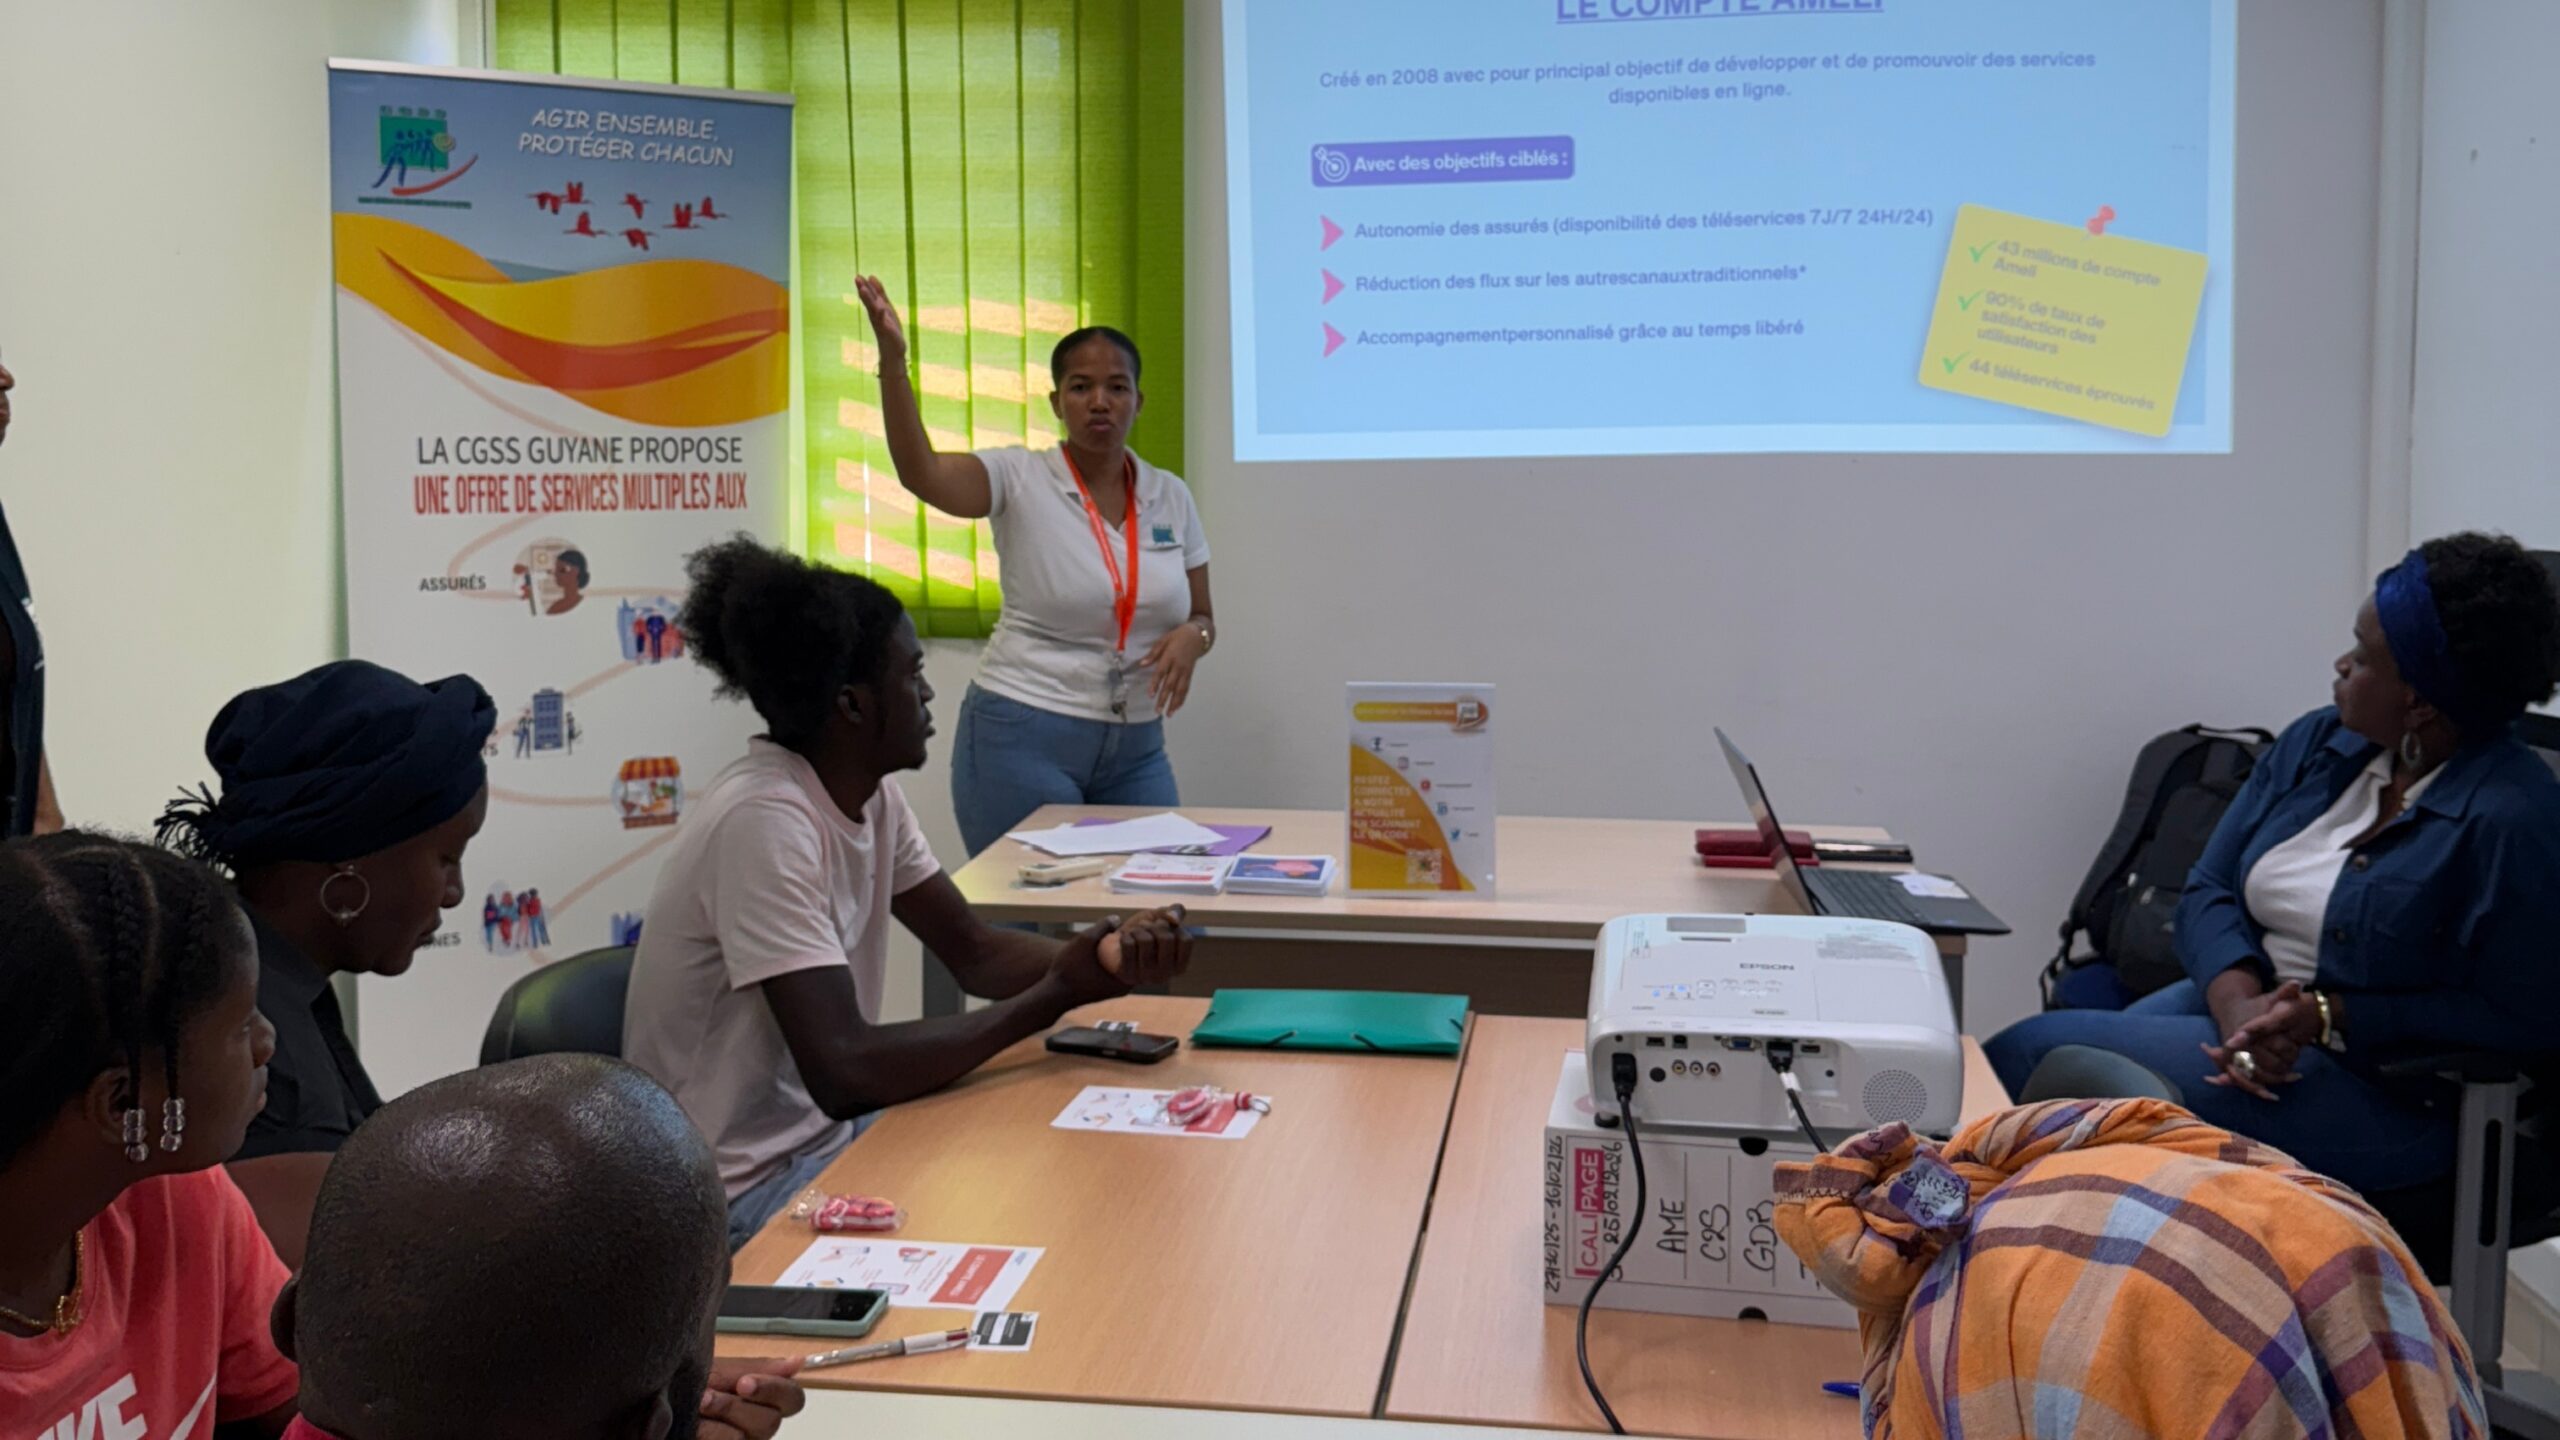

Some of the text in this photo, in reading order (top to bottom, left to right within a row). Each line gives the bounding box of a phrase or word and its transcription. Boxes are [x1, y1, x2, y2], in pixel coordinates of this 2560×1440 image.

[1319, 51, 2096, 88] Créé en 2008 avec pour principal objectif de développer et de promouvoir des services
[1608, 82, 1793, 106] disponibles en ligne.
[532, 108, 719, 142] AGIR ENSEMBLE,
[518, 129, 734, 166] PROTÉGER CHACUN
[1354, 156, 1396, 173] Avec
[1398, 155, 1431, 171] des
[1433, 151, 1506, 174] objectifs
[1508, 150, 1560, 167] ciblés
[1354, 208, 1935, 239] Autonomie des assurés (disponibilité des téléservices 7J/7 24H/24)
[1356, 274, 1441, 292] Réduction
[1445, 273, 1477, 289] des
[1480, 272, 1511, 289] flux
[1514, 274, 1543, 288] sur
[1546, 271, 1571, 287] les
[2022, 246, 2079, 270] millions
[2082, 258, 2101, 275] de
[2103, 265, 2161, 287] compte
[1982, 310, 2097, 344] satisfaction des
[2028, 302, 2048, 317] de
[2050, 305, 2083, 325] taux
[2085, 314, 2106, 330] de
[1356, 318, 1805, 347] Accompagnementpersonnalisé grâce au temps libéré
[1977, 328, 2059, 355] utilisateurs
[1969, 358, 2156, 412] 44 téléservices éprouvés
[417, 435, 743, 465] LA CGSS GUYANE PROPOSE
[414, 472, 748, 515] UNE OFFRE DE SERVICES MULTIPLES AUX
[419, 572, 487, 592] ASSURÉS
[1739, 962, 1795, 971] EPSON
[1580, 1151, 1599, 1268] CALIPAGE
[1656, 1197, 1689, 1254] AME
